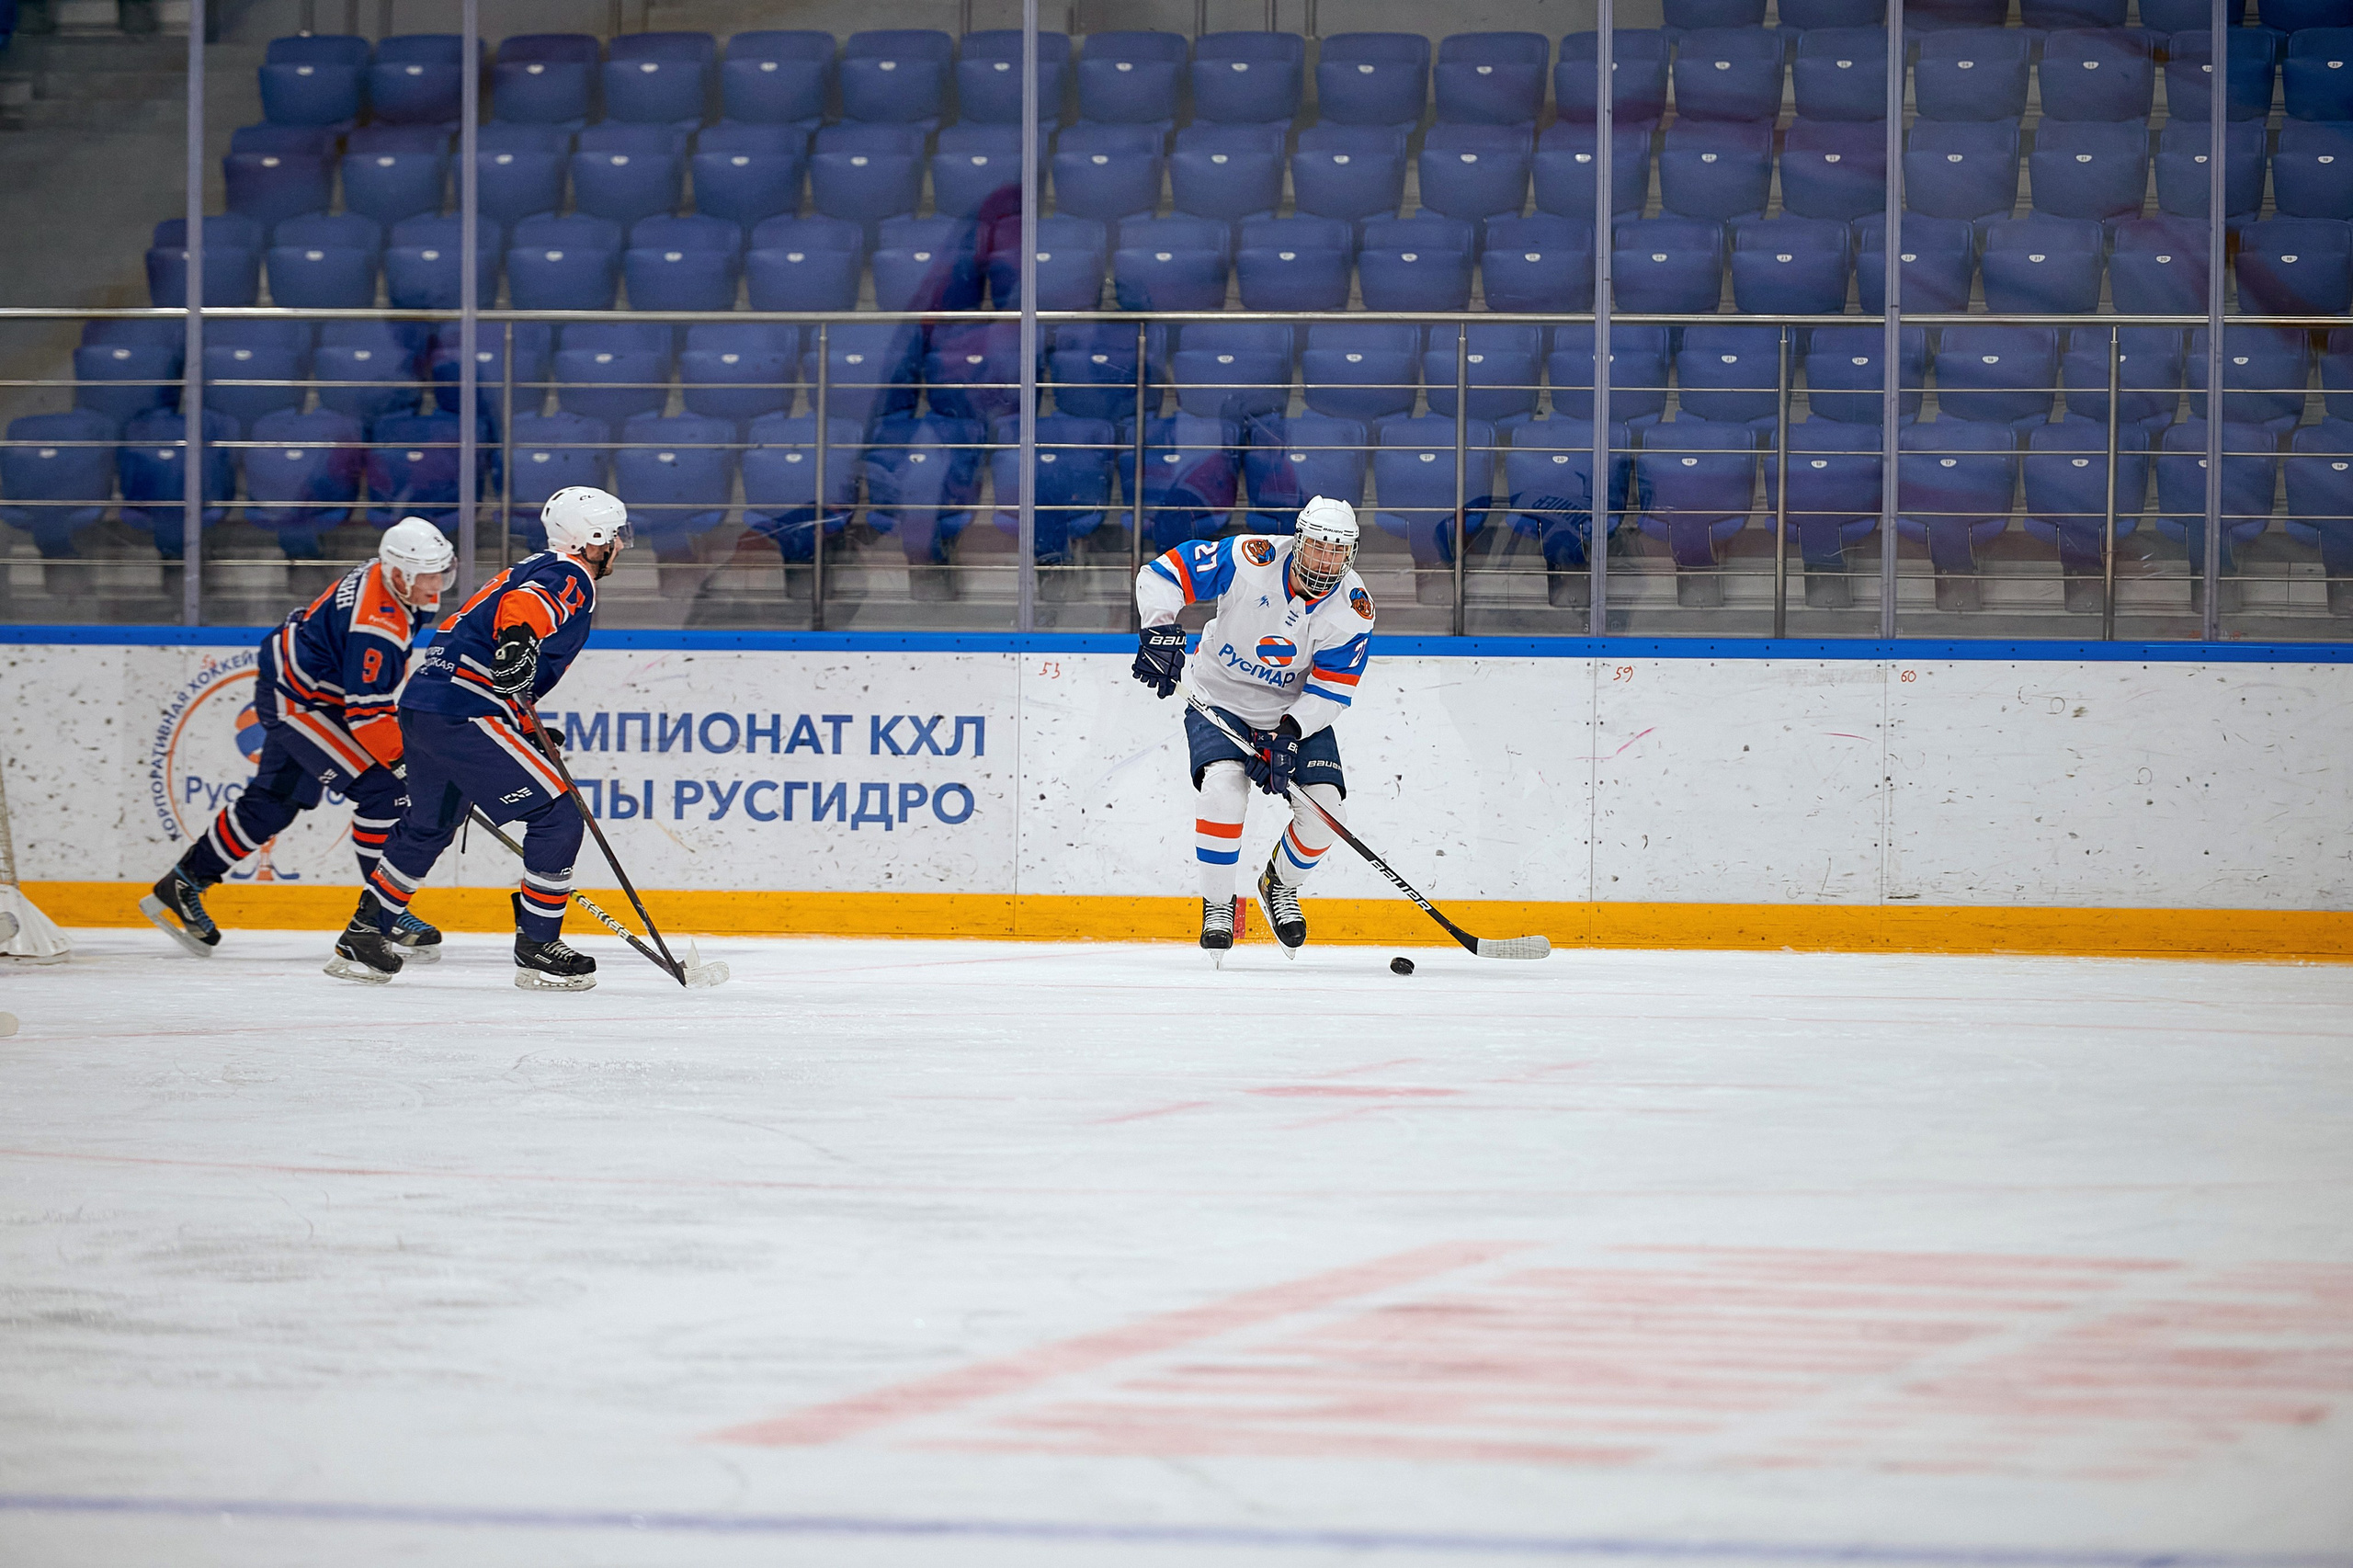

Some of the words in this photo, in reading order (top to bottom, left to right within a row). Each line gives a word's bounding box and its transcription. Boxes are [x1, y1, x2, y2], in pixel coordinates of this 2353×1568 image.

[1194, 540, 1220, 573] 27
[362, 647, 383, 684] 9
[1218, 642, 1298, 688] РусГидр
[1612, 665, 1635, 683] 59
[1900, 669, 1917, 684] 60
[870, 715, 985, 756] КХЛ
[574, 779, 653, 820] ПЫ
[674, 780, 975, 831] РУСГИДРО
[1370, 859, 1432, 912] BAUER
